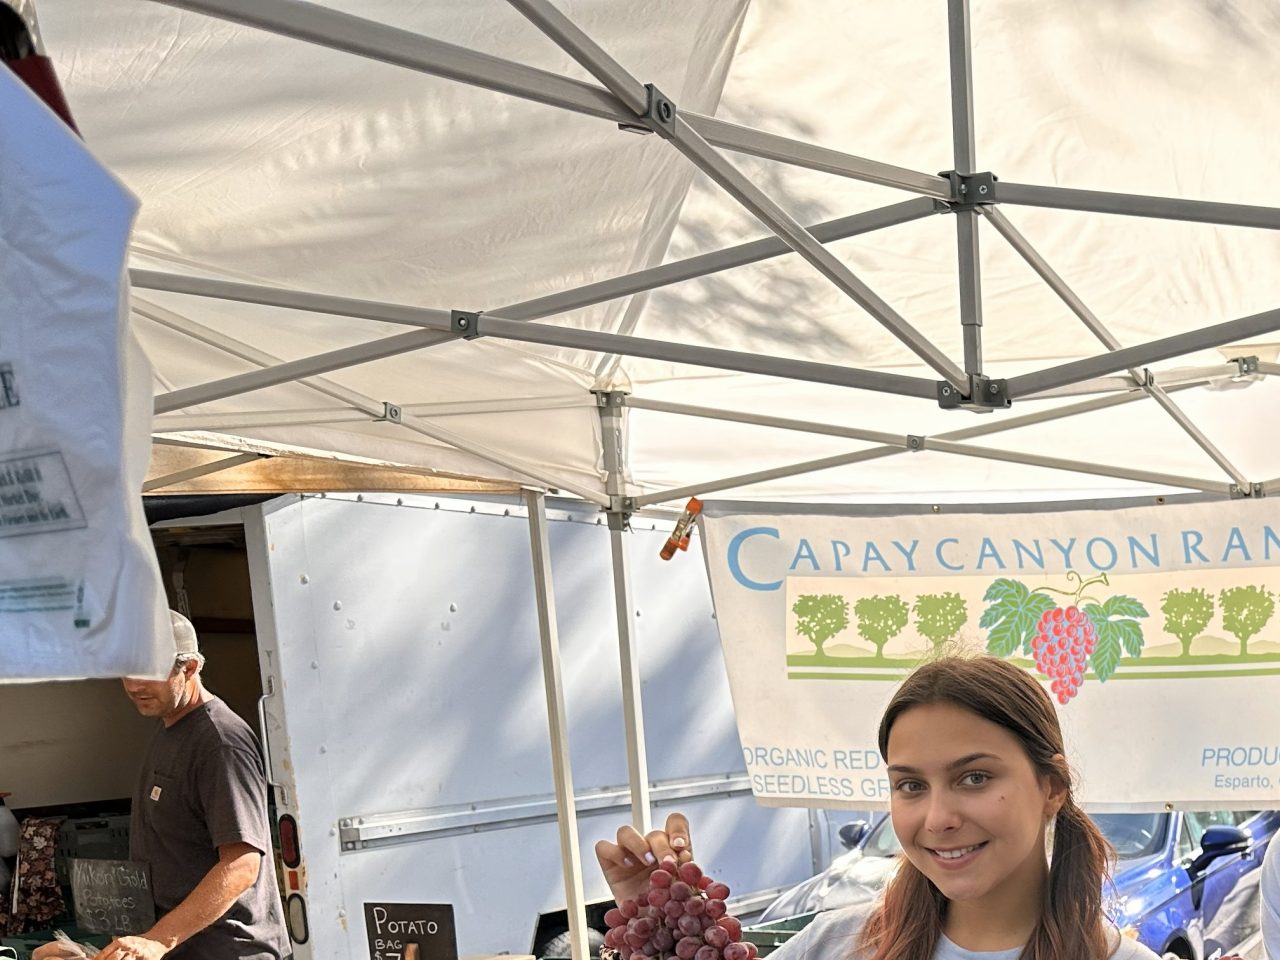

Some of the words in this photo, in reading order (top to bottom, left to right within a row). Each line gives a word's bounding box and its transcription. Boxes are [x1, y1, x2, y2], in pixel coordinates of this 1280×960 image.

[727, 526, 920, 592] CAPAY
[934, 533, 1161, 572] CANYON
[834, 750, 880, 770] RED
[752, 774, 855, 797] SEEDLESS
[1214, 774, 1274, 791] Esparto,
[117, 867, 148, 890] Gold
[375, 939, 402, 950] BAG
